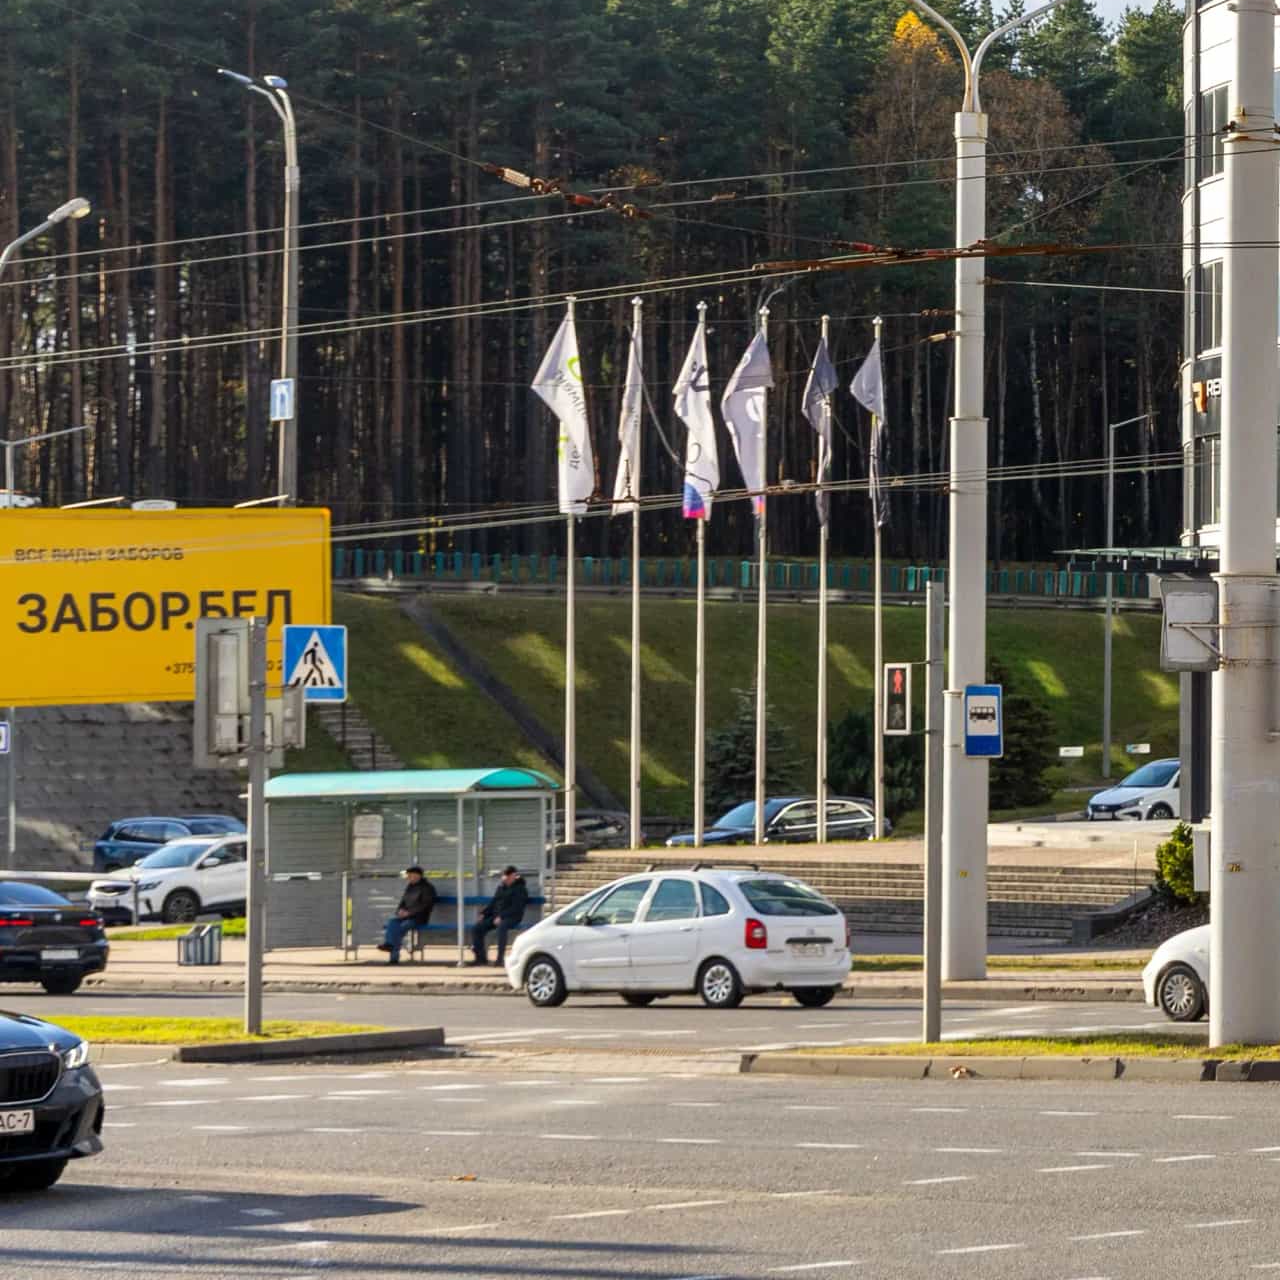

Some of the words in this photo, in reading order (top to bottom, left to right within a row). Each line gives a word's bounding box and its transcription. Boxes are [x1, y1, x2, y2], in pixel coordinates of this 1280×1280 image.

[52, 548, 102, 563] ВИДЫ
[106, 547, 184, 561] ЗАБОРОВ
[17, 589, 293, 634] ЗАБОР.БЕЛ
